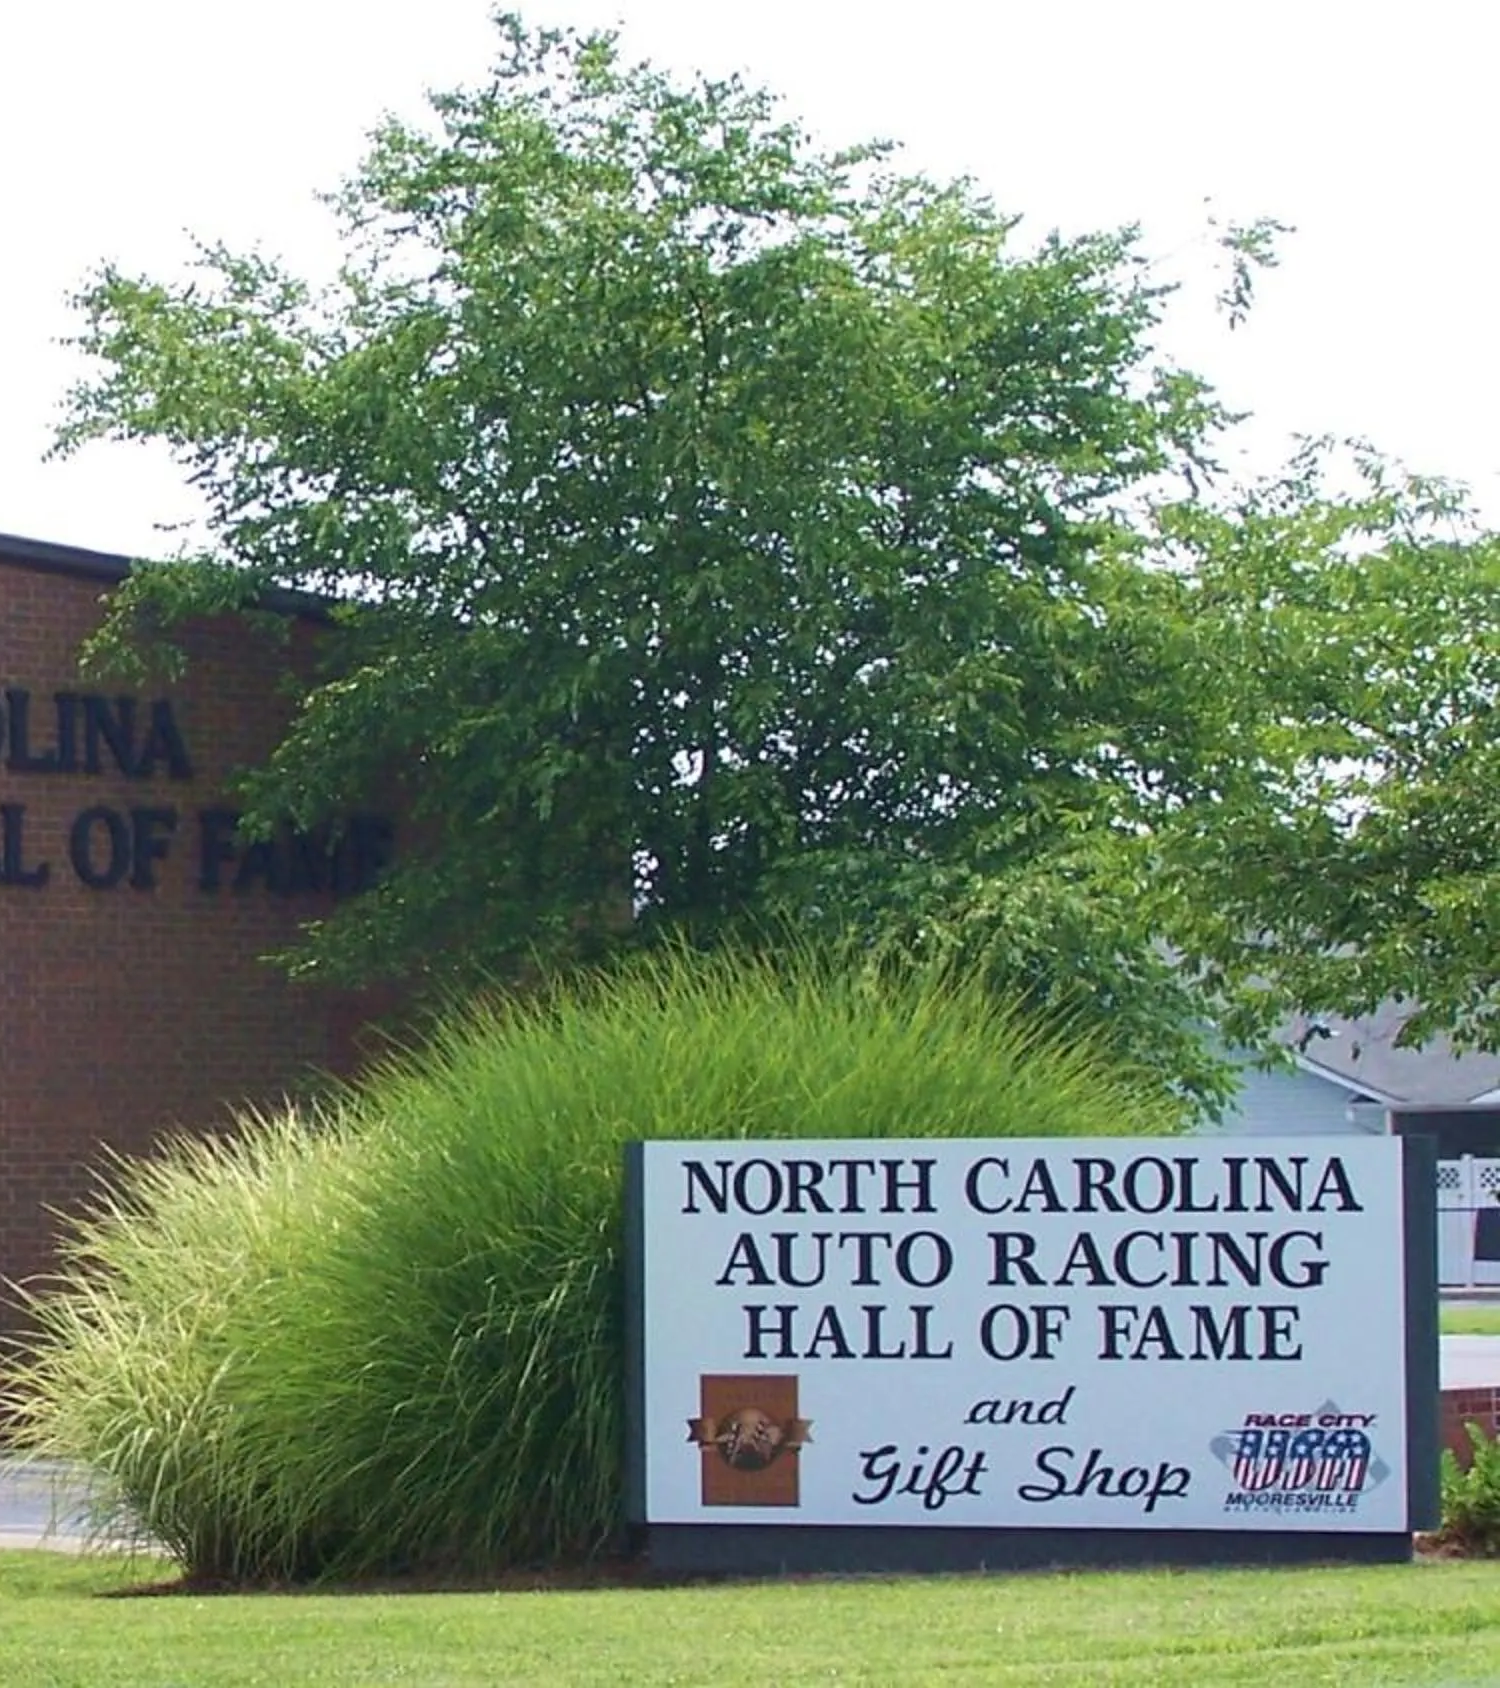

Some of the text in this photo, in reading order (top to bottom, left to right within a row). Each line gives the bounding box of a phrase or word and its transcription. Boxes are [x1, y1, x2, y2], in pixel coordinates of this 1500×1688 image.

[70, 804, 177, 890] OF
[681, 1156, 1364, 1215] NORTH CAROLINA
[715, 1230, 1330, 1289] AUTO RACING
[742, 1304, 1303, 1361] HALL OF FAME
[963, 1386, 1077, 1426] and
[1245, 1414, 1378, 1428] RACE CITY
[851, 1445, 1192, 1514] Gift Shop
[1233, 1429, 1372, 1491] USA
[1225, 1492, 1359, 1507] MOORESVILLE
